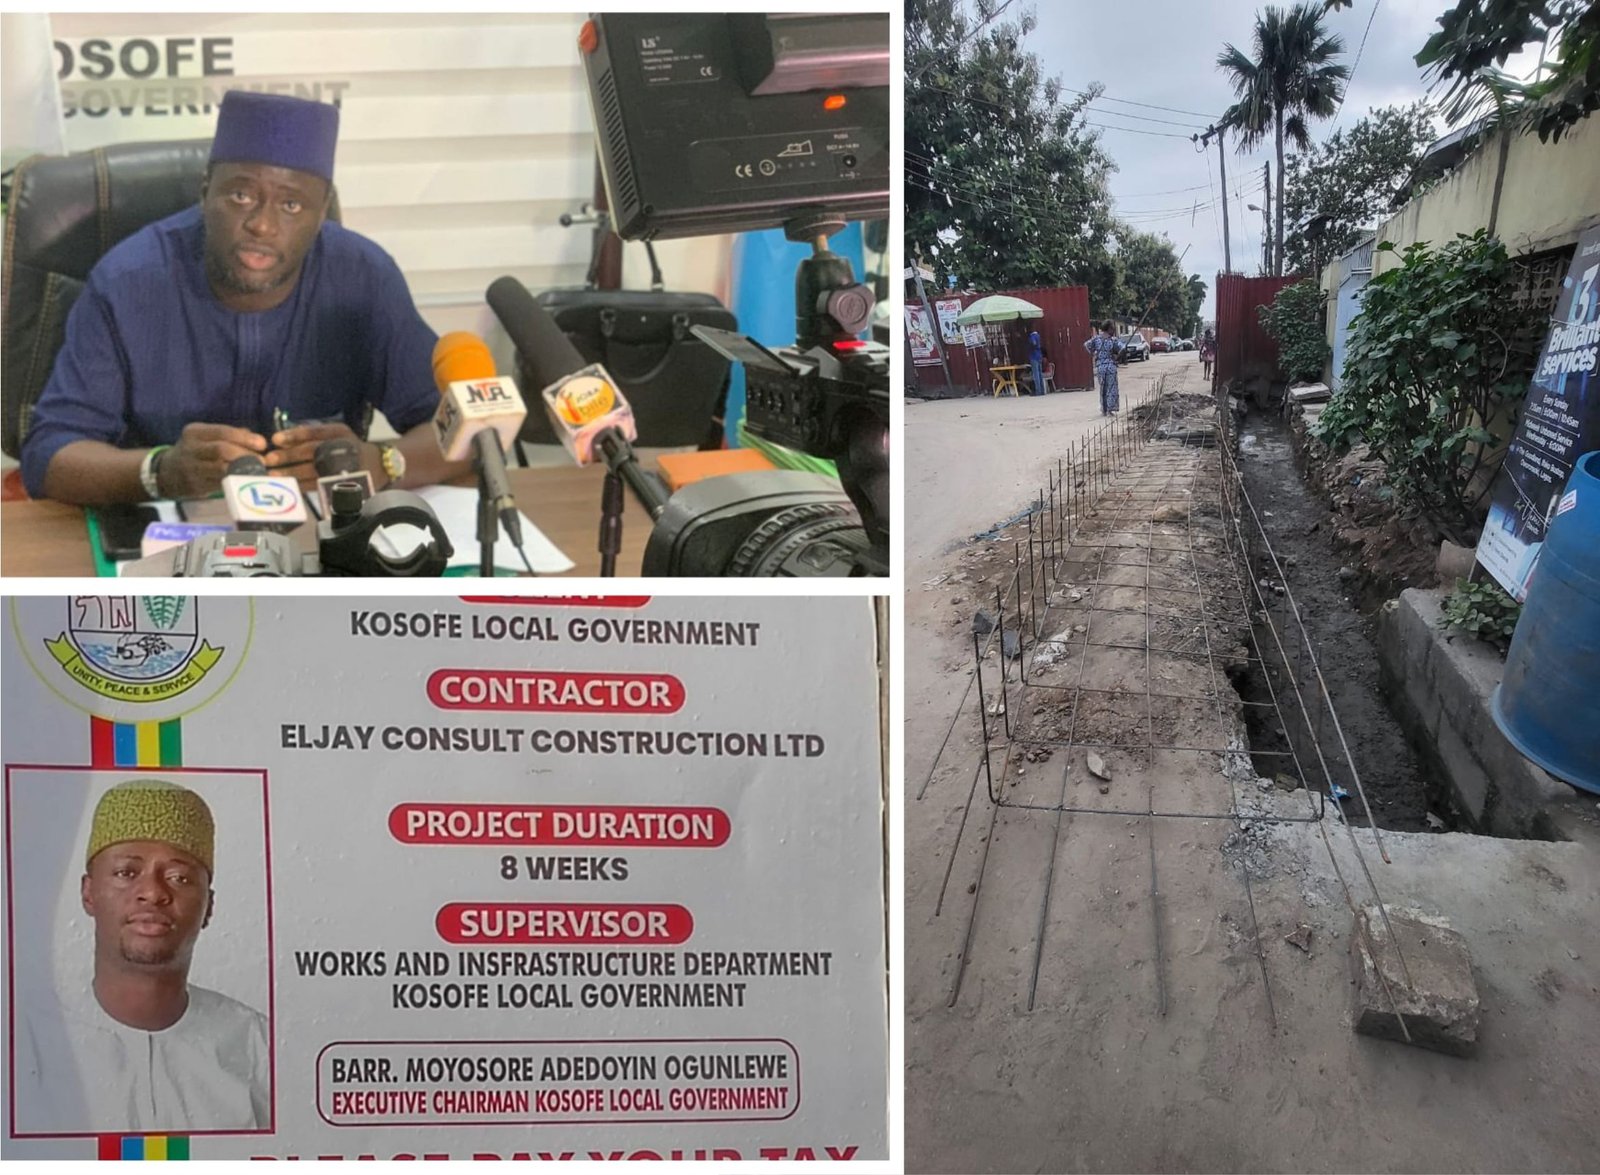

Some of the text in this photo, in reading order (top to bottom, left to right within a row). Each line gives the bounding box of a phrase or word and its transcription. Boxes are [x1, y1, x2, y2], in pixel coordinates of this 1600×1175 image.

[1541, 346, 1598, 377] services
[350, 611, 760, 646] KOSOFE LOCAL GOVERNMENT
[104, 682, 140, 696] PEACE
[142, 686, 150, 695] &
[152, 671, 194, 695] SERVICE
[440, 676, 672, 707] CONTRACTOR
[281, 724, 825, 758] ELJAY CONSULT CONSTRUCTION LTD
[407, 810, 713, 840] PROJECT DURATION
[500, 855, 630, 881] 8 WEEKS
[459, 909, 670, 937] SUPERVISOR
[294, 951, 833, 977] WORKS AND INSFRASTRUCTURE DEPARTMENT
[392, 982, 748, 1009] KOSOFE LOCAL GOVERNMENT
[332, 1054, 788, 1084] BARR. MOYOSORE ADEDOYIN OGUNLEWE
[332, 1086, 788, 1117] EXECUTIVE CHAIRMAN KOSOFE LOCAL GOVERNMENT
